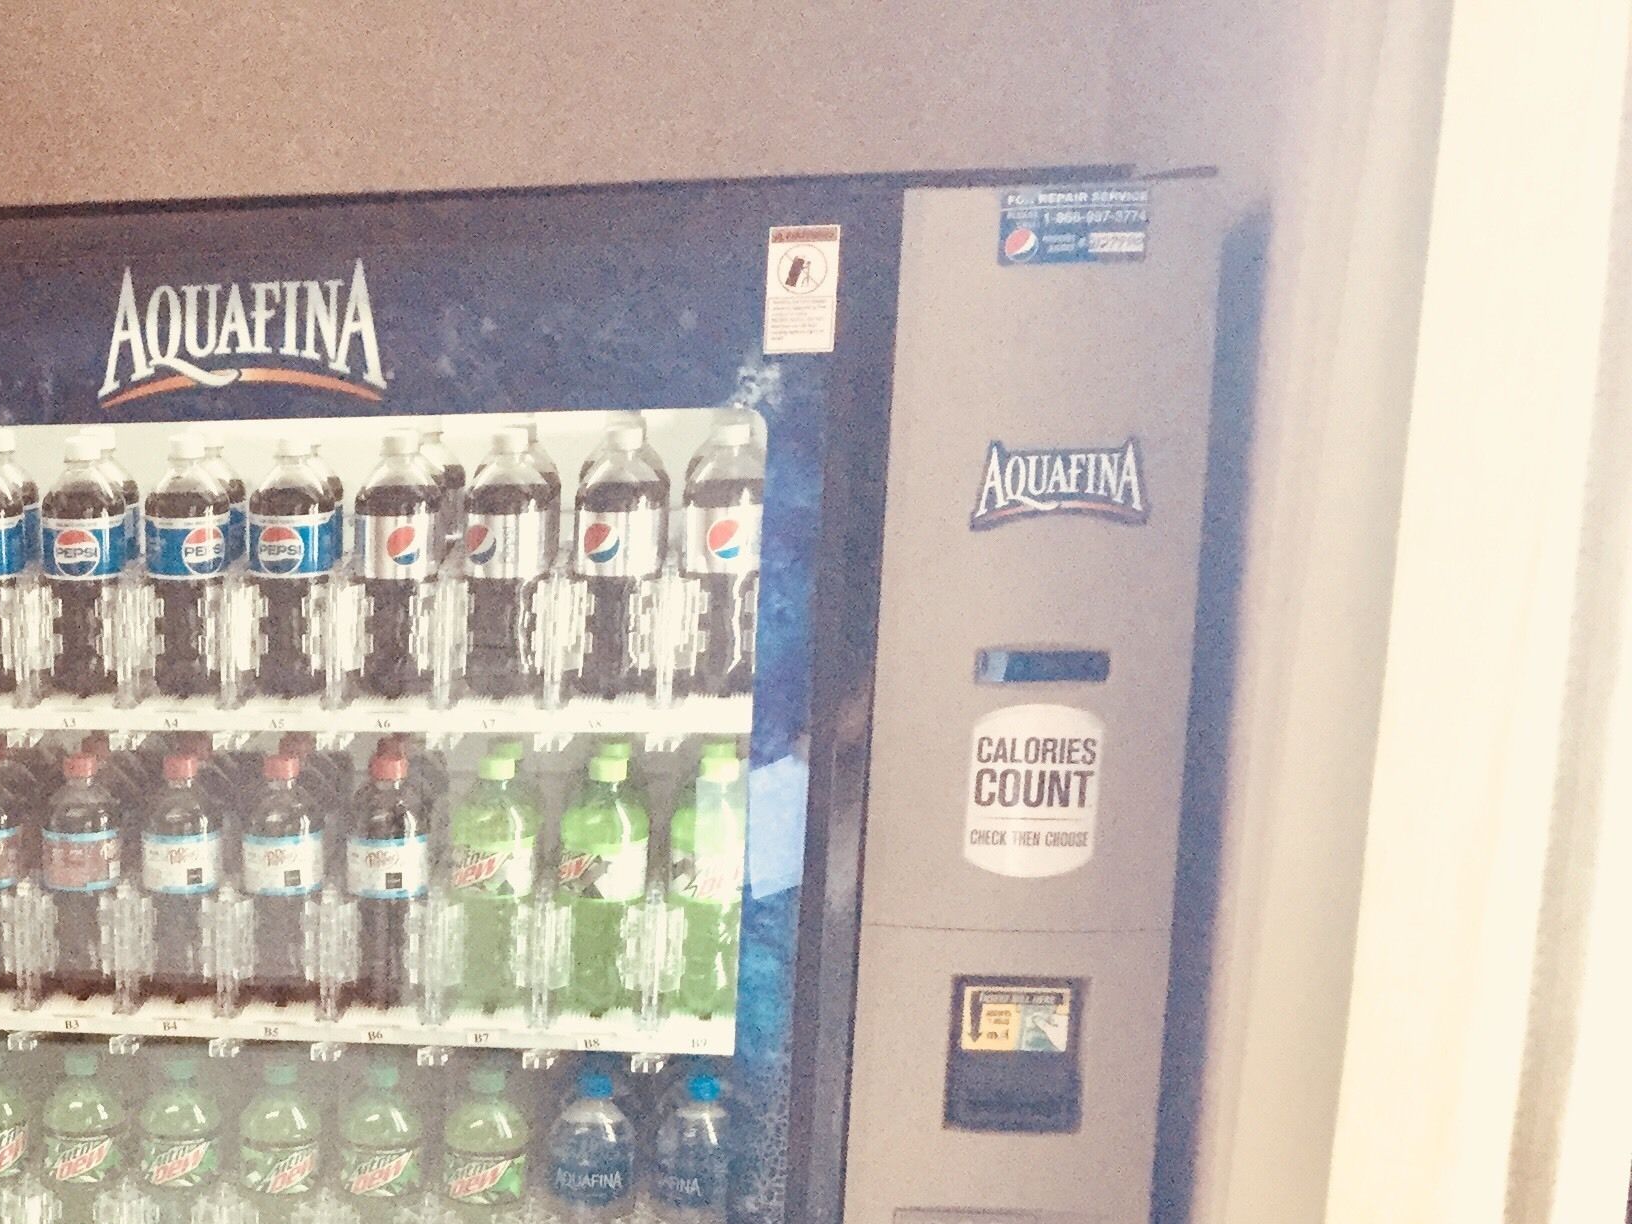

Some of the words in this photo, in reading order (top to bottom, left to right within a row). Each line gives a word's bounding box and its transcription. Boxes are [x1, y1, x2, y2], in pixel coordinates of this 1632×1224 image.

[98, 257, 387, 398] AQUAFINA
[975, 443, 1143, 516] AQUAFINA
[55, 547, 98, 561] PEPSI
[259, 542, 304, 558] PEPSI
[976, 736, 1097, 766] CALORIES
[973, 768, 1095, 809] COUNT
[970, 829, 1007, 846] CHECK
[1012, 830, 1041, 847] THEN
[1045, 831, 1089, 847] CHOOSE
[368, 1029, 384, 1041] B6
[474, 1032, 490, 1044] B7
[583, 1036, 601, 1049] B8
[555, 1166, 624, 1190] AQUAFINA
